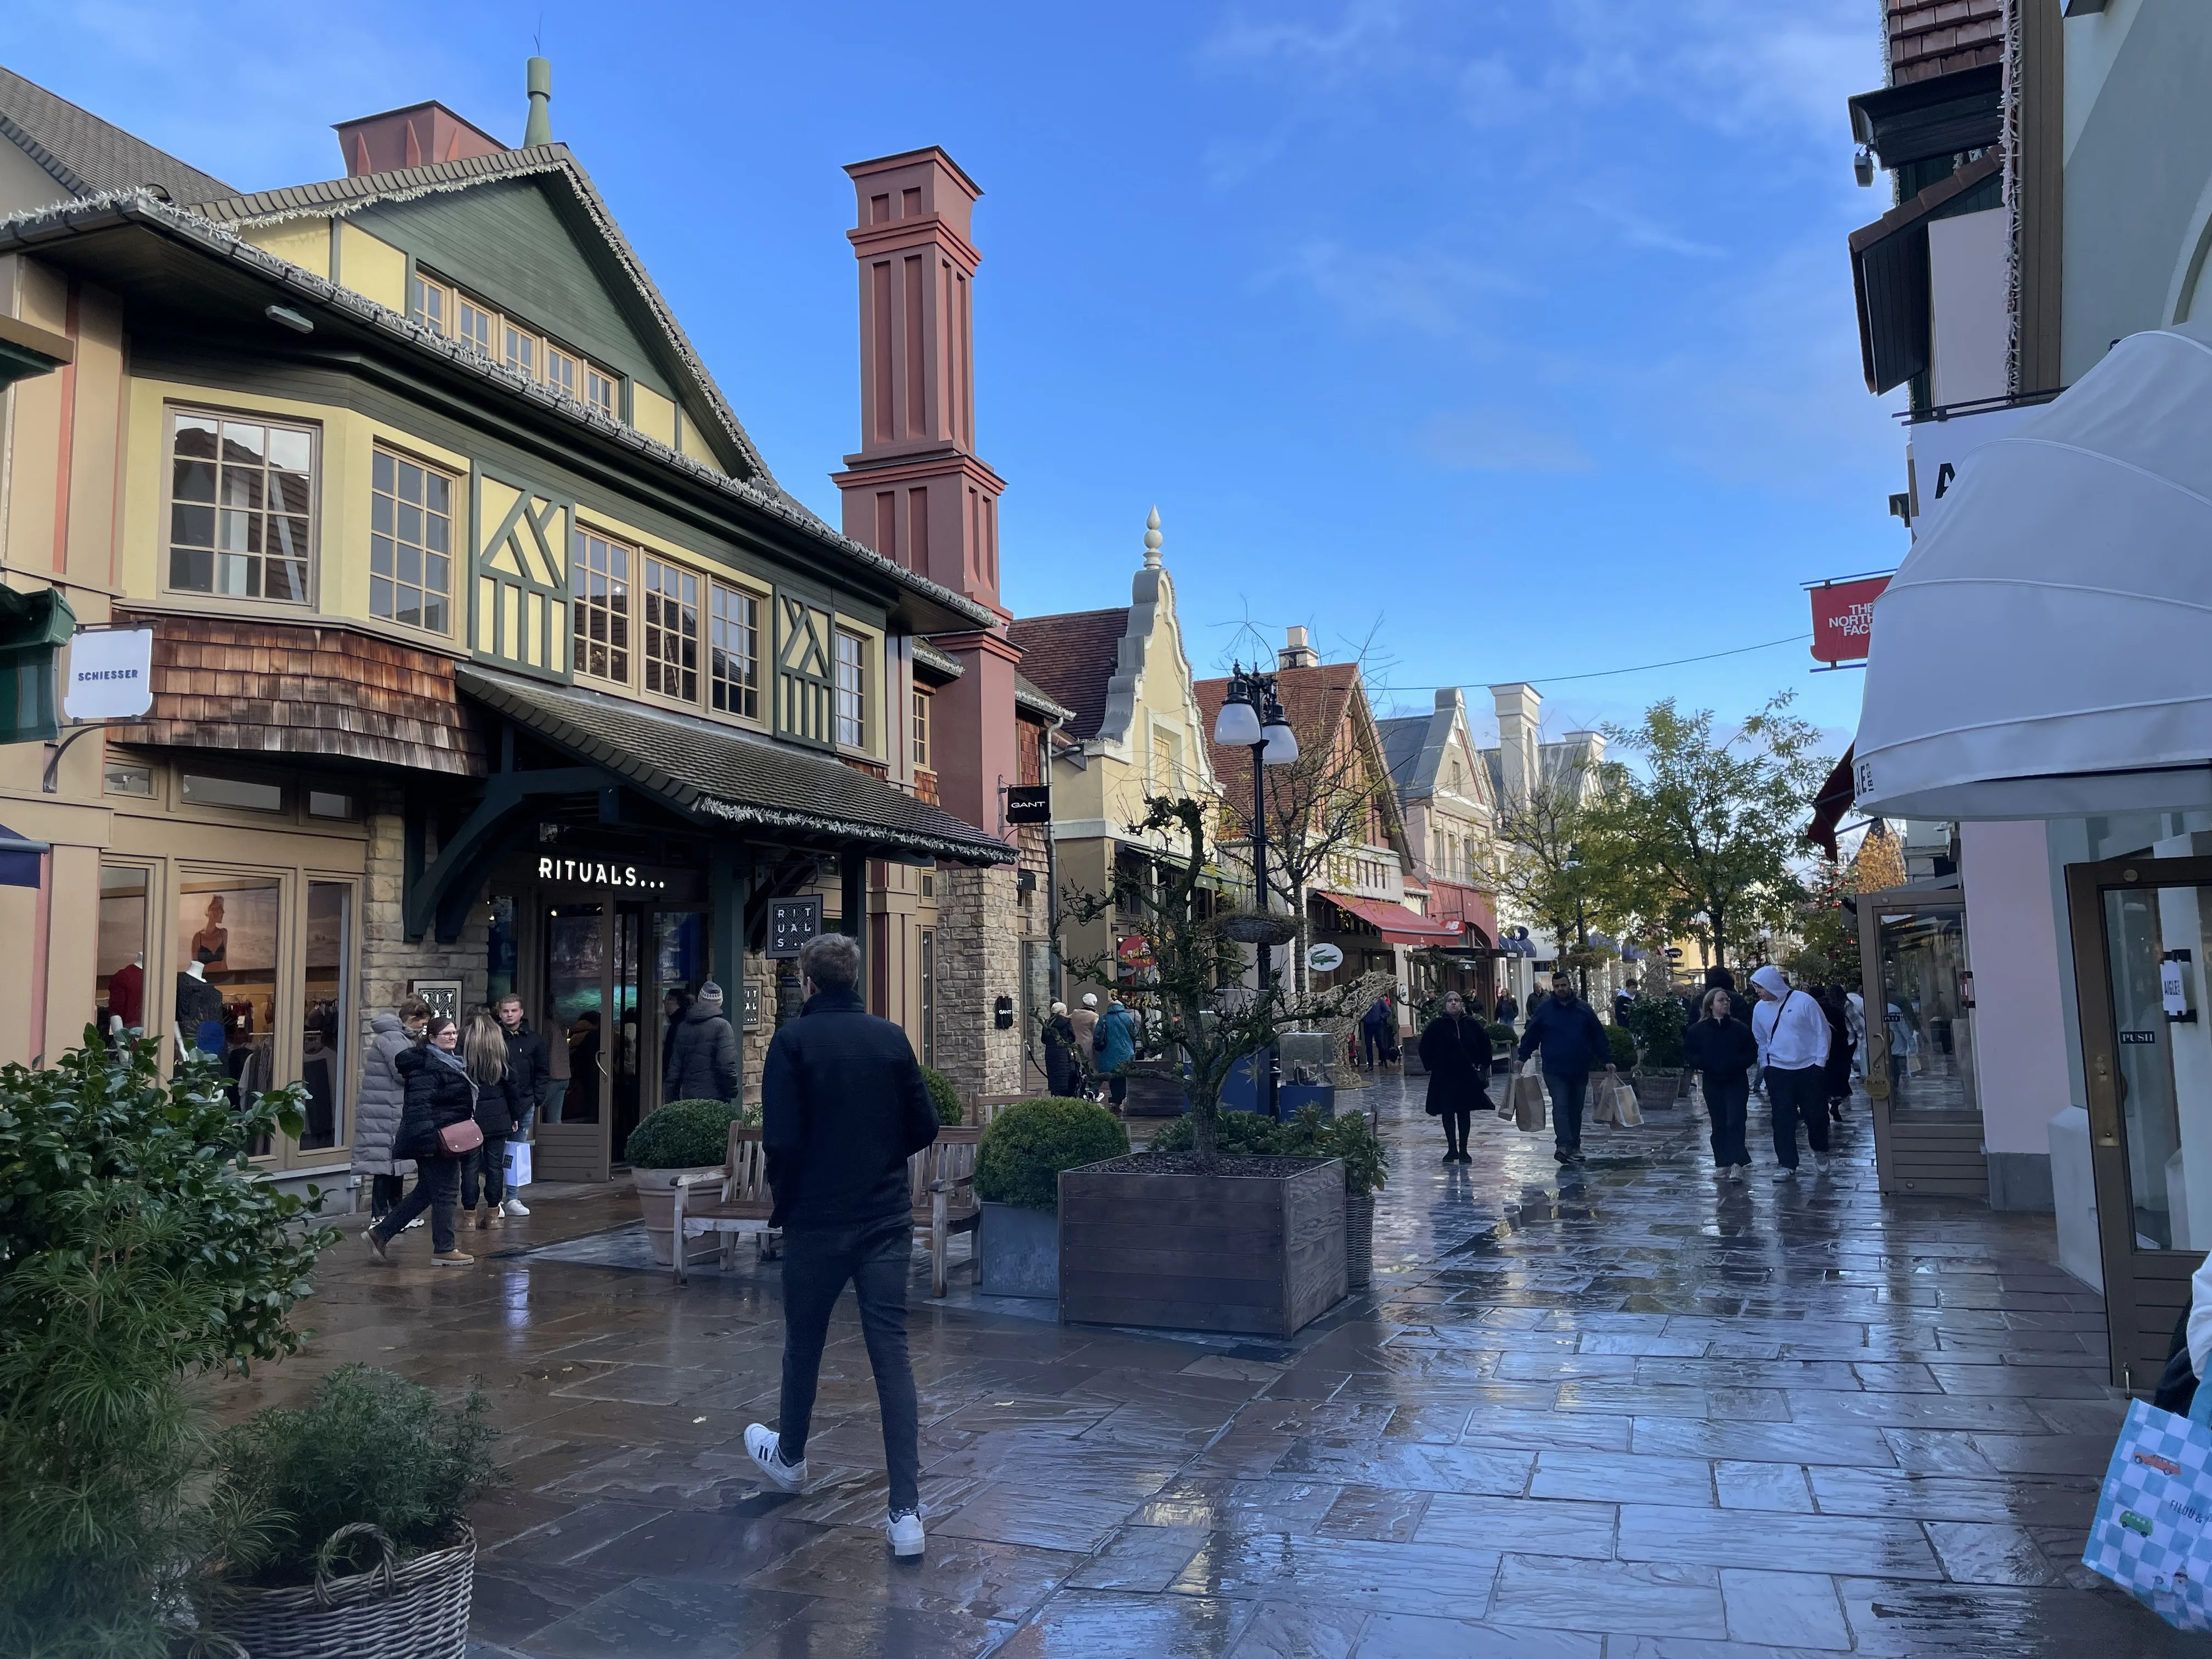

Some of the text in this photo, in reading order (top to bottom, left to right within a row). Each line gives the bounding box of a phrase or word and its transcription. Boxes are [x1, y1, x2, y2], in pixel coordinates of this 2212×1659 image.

[1848, 602, 1873, 615] THE
[78, 669, 138, 681] SCHIESSER
[539, 857, 664, 888] RITUALS...
[2122, 1033, 2153, 1042] PUSH
